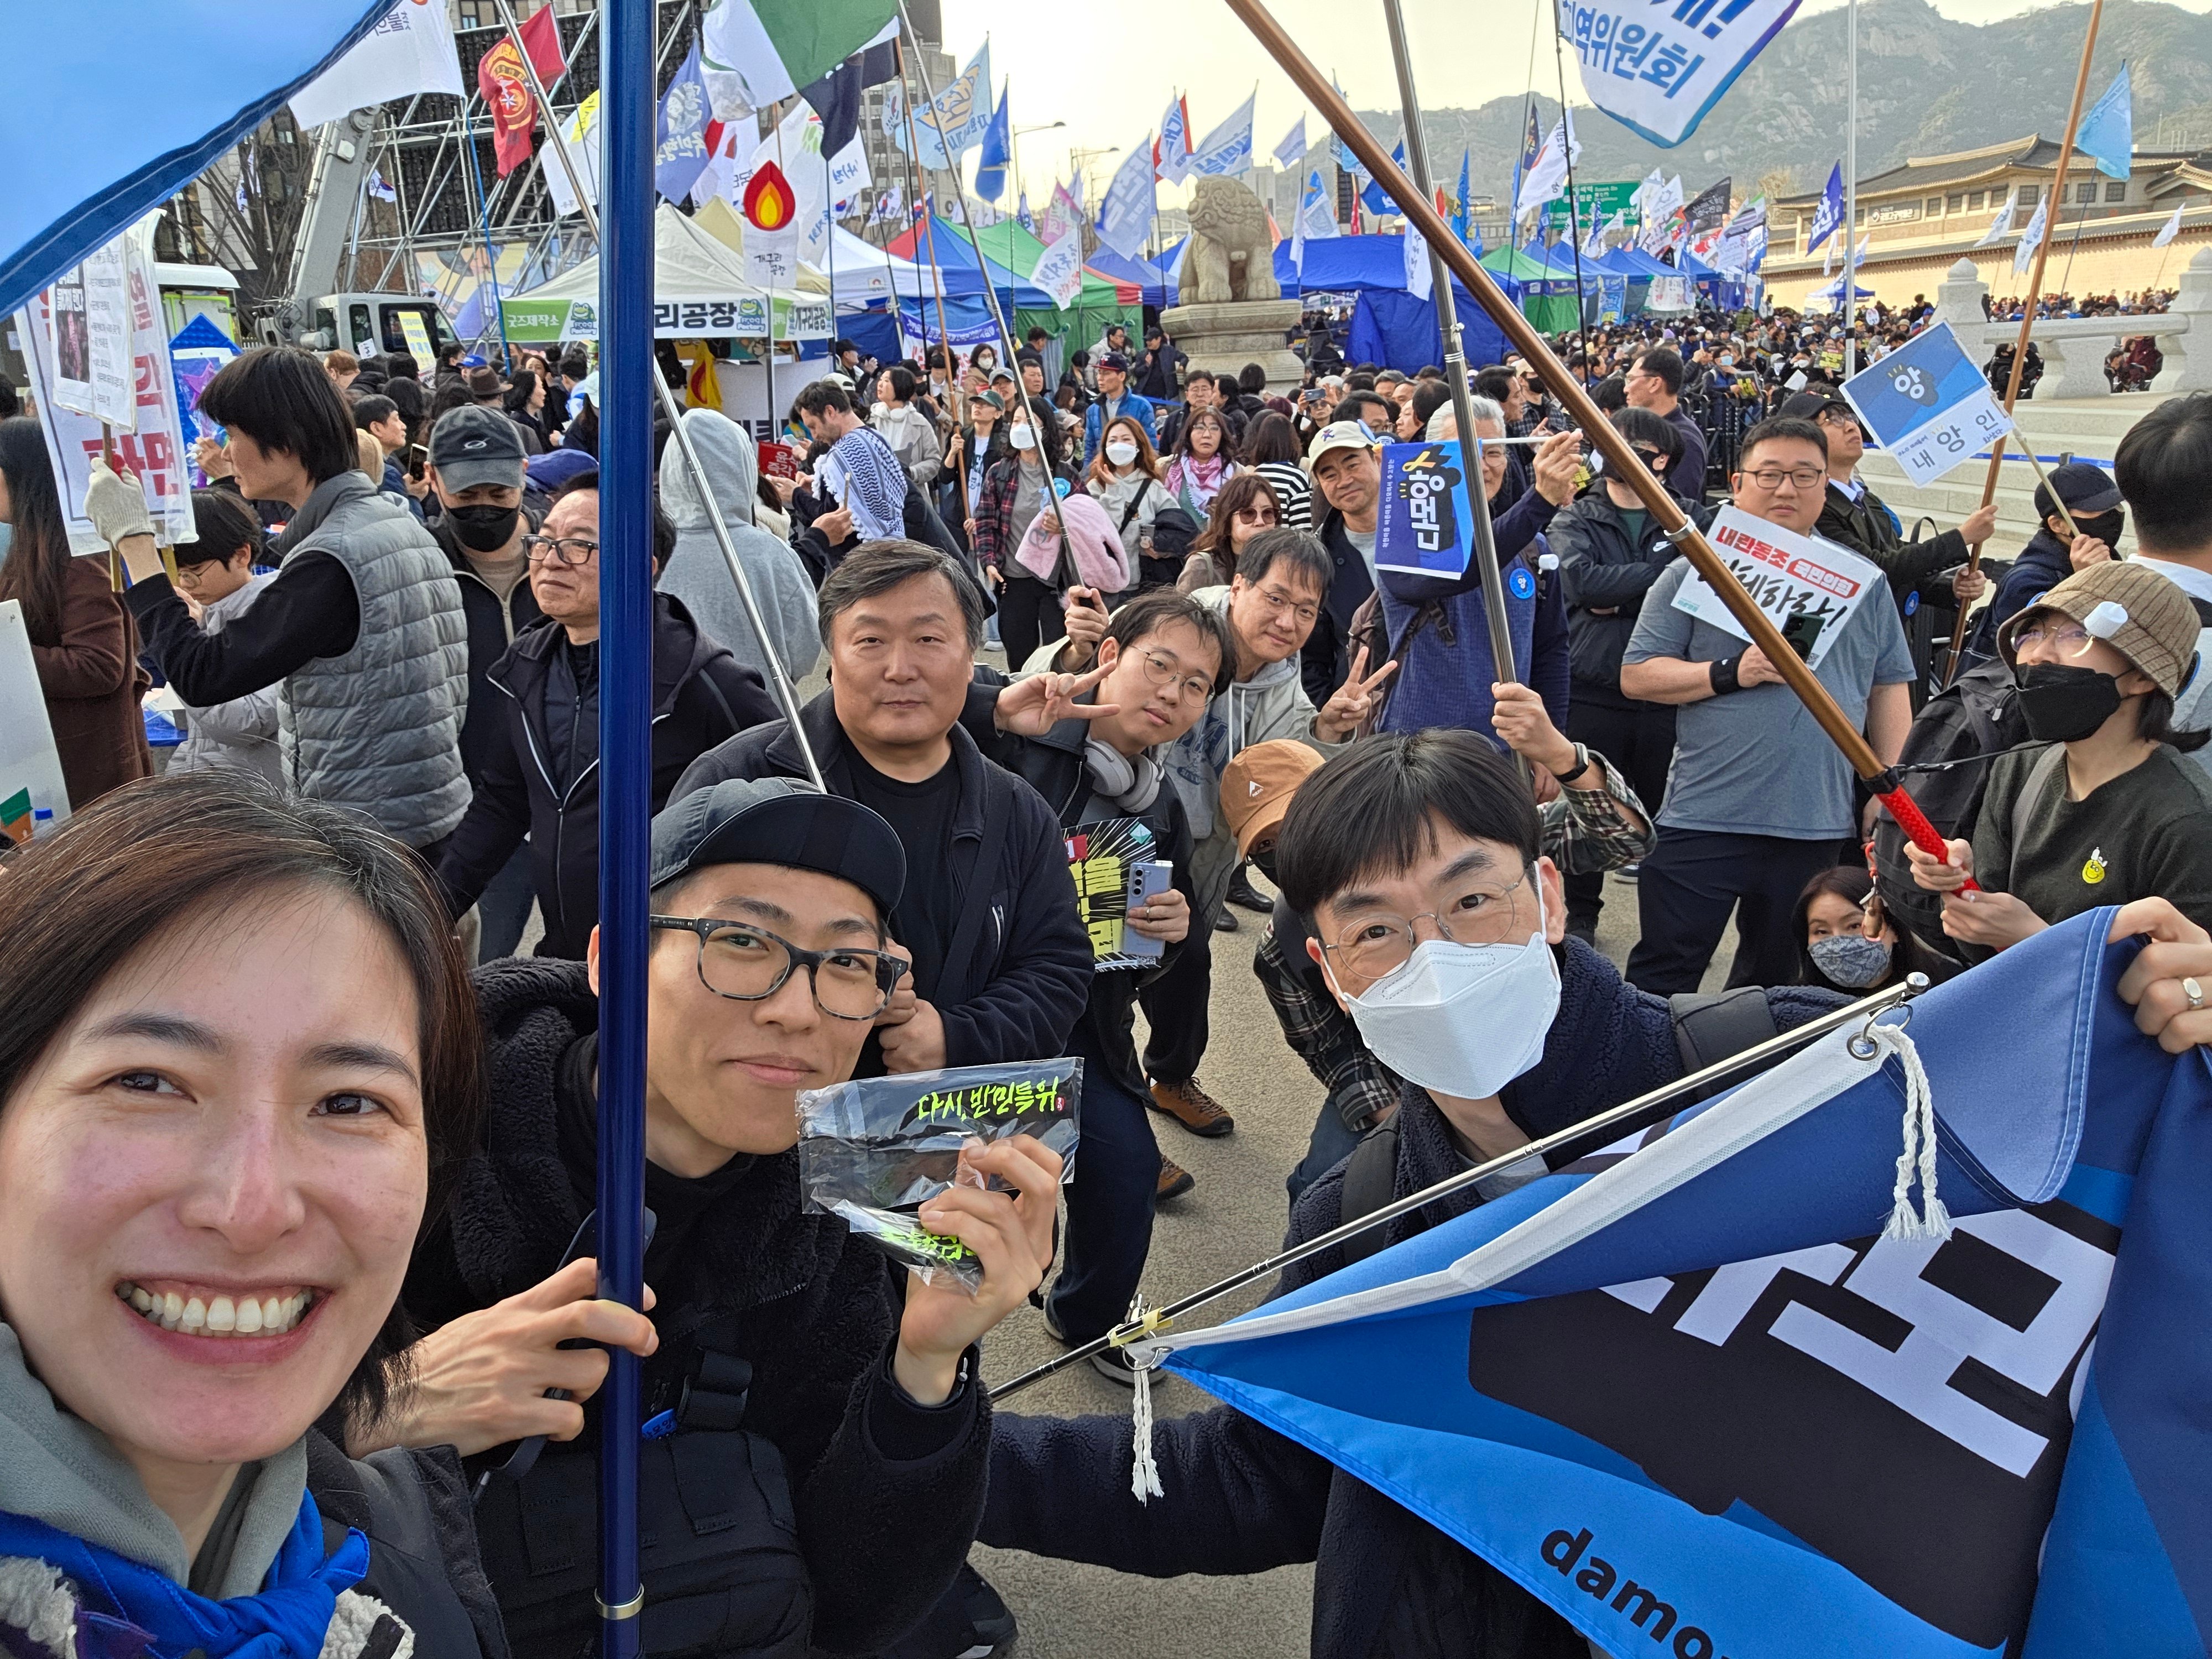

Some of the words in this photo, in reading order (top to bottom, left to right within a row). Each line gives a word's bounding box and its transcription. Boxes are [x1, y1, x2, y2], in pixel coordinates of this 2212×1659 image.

[754, 253, 782, 266] 개구리
[770, 264, 786, 276] 공장
[507, 314, 560, 328] 굿즈제작소
[1894, 366, 1924, 399] 앙
[1912, 448, 1936, 469] 내
[1937, 424, 1966, 453] 앙
[1975, 409, 1999, 432] 인
[1408, 469, 1446, 551] 다모앙
[1715, 525, 1791, 570] 내란동조
[1793, 559, 1854, 598] 국민의힘
[1540, 1527, 1731, 1659] damo
